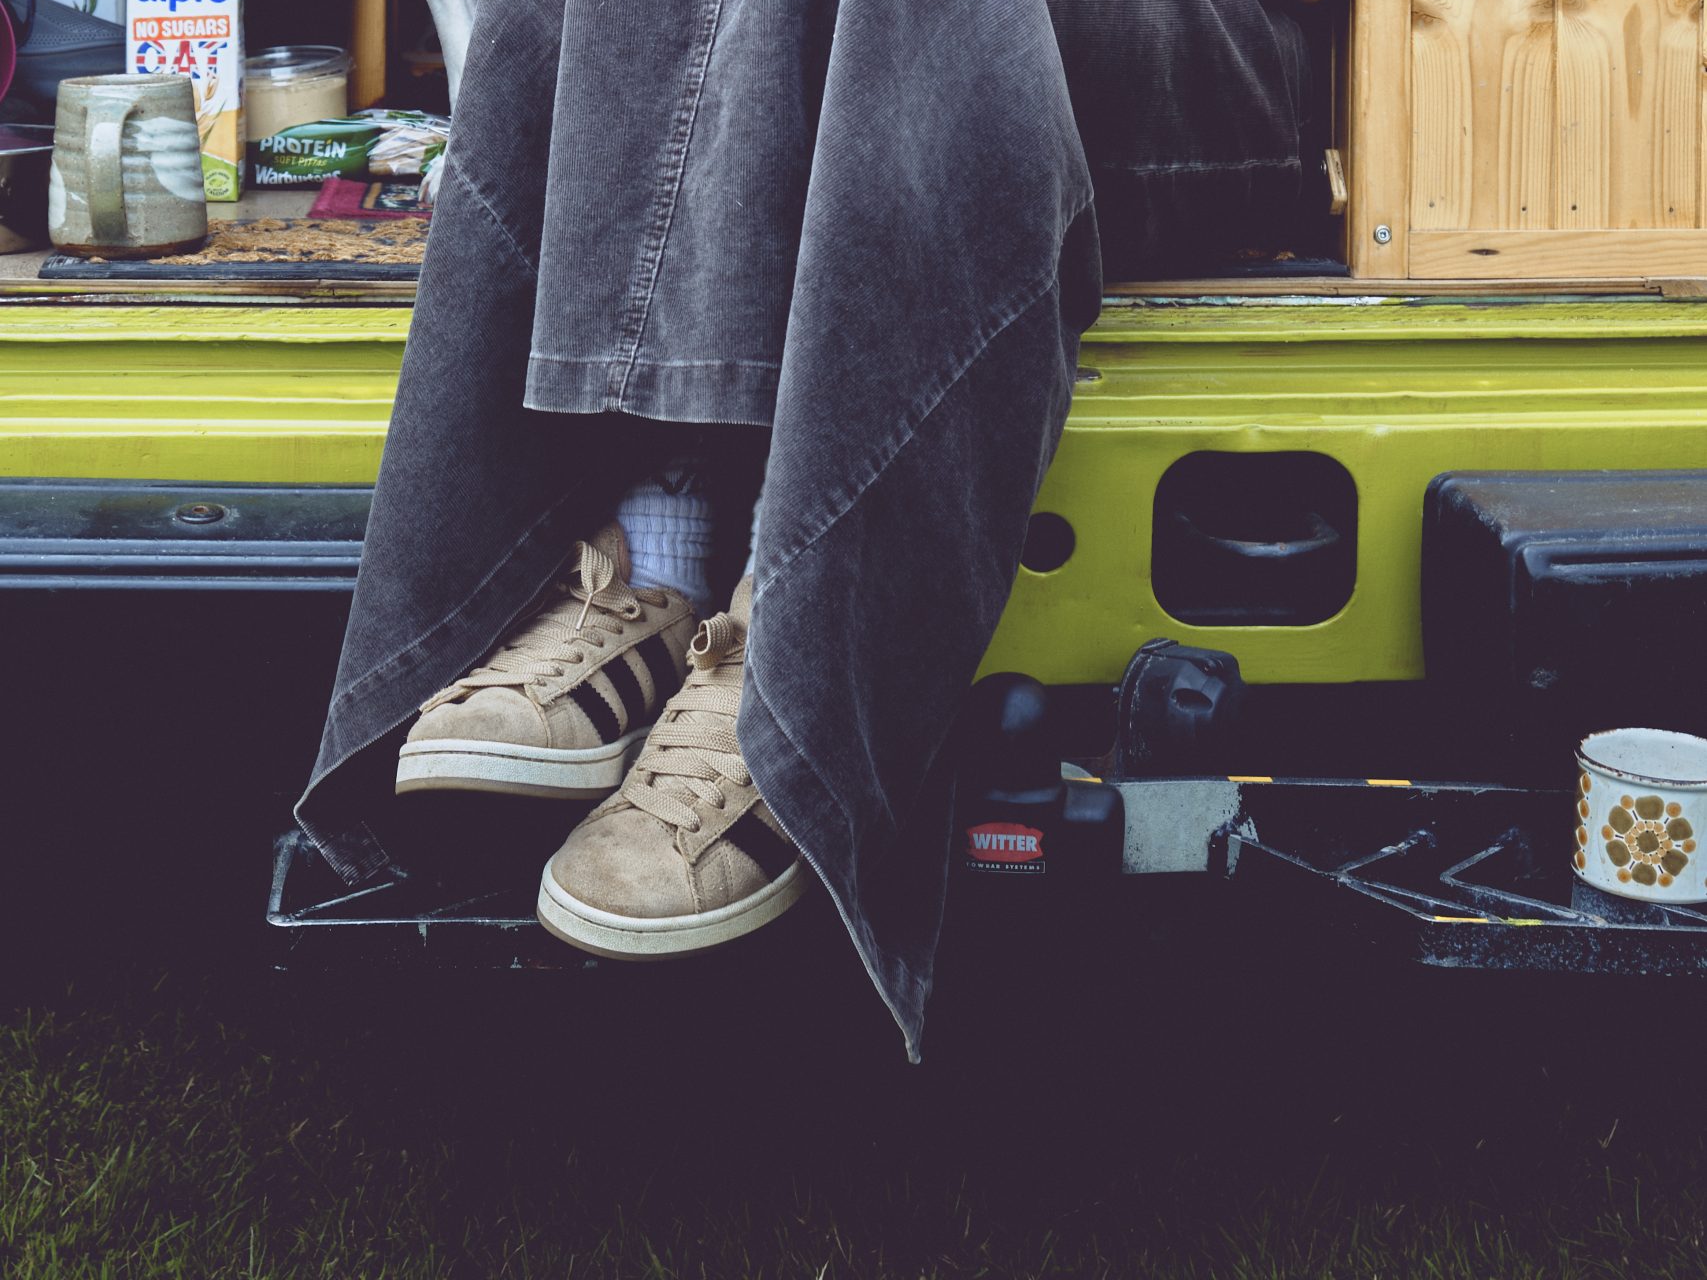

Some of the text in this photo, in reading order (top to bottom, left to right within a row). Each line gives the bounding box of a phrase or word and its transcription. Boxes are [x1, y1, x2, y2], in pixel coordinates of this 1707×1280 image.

[135, 18, 228, 38] NO SUGARS
[136, 40, 228, 79] OAT
[274, 155, 328, 167] SOFT PITTAS
[973, 833, 1038, 852] WITTER
